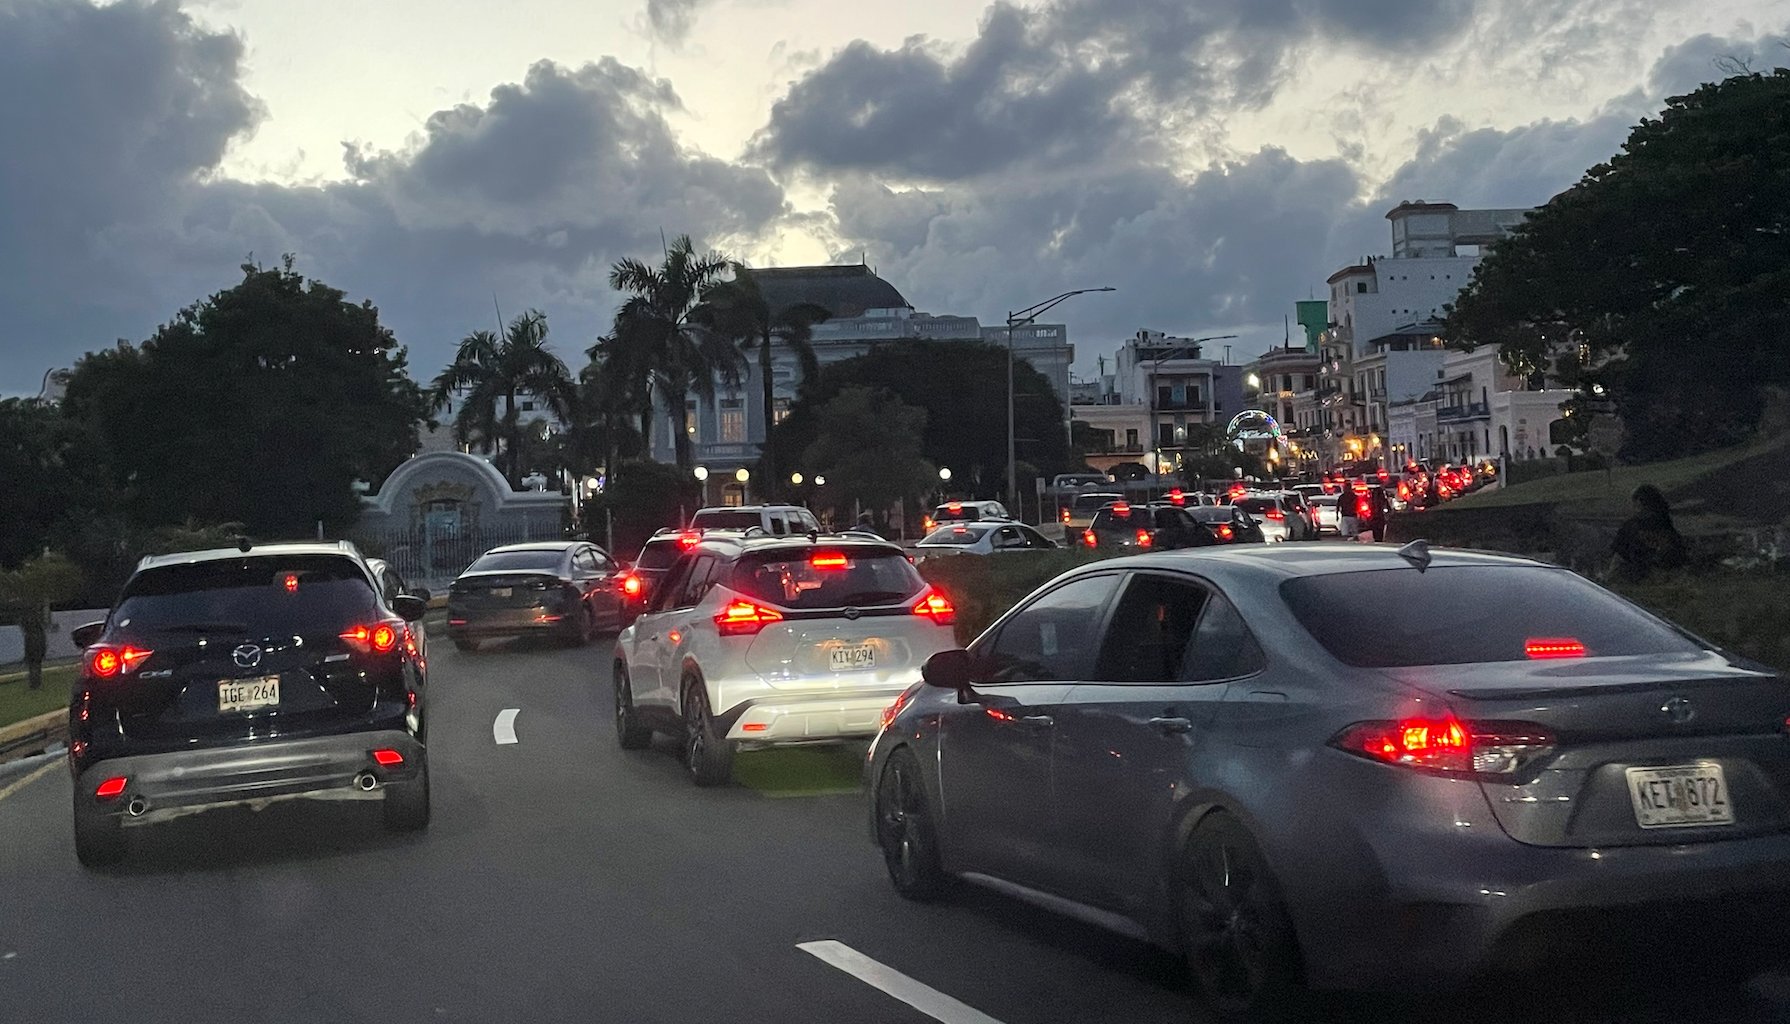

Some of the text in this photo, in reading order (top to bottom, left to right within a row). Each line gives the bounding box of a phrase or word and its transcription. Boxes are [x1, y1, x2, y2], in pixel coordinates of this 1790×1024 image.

[832, 649, 873, 663] KIY 294
[222, 684, 276, 704] IGE 264
[1637, 780, 1676, 810] KET
